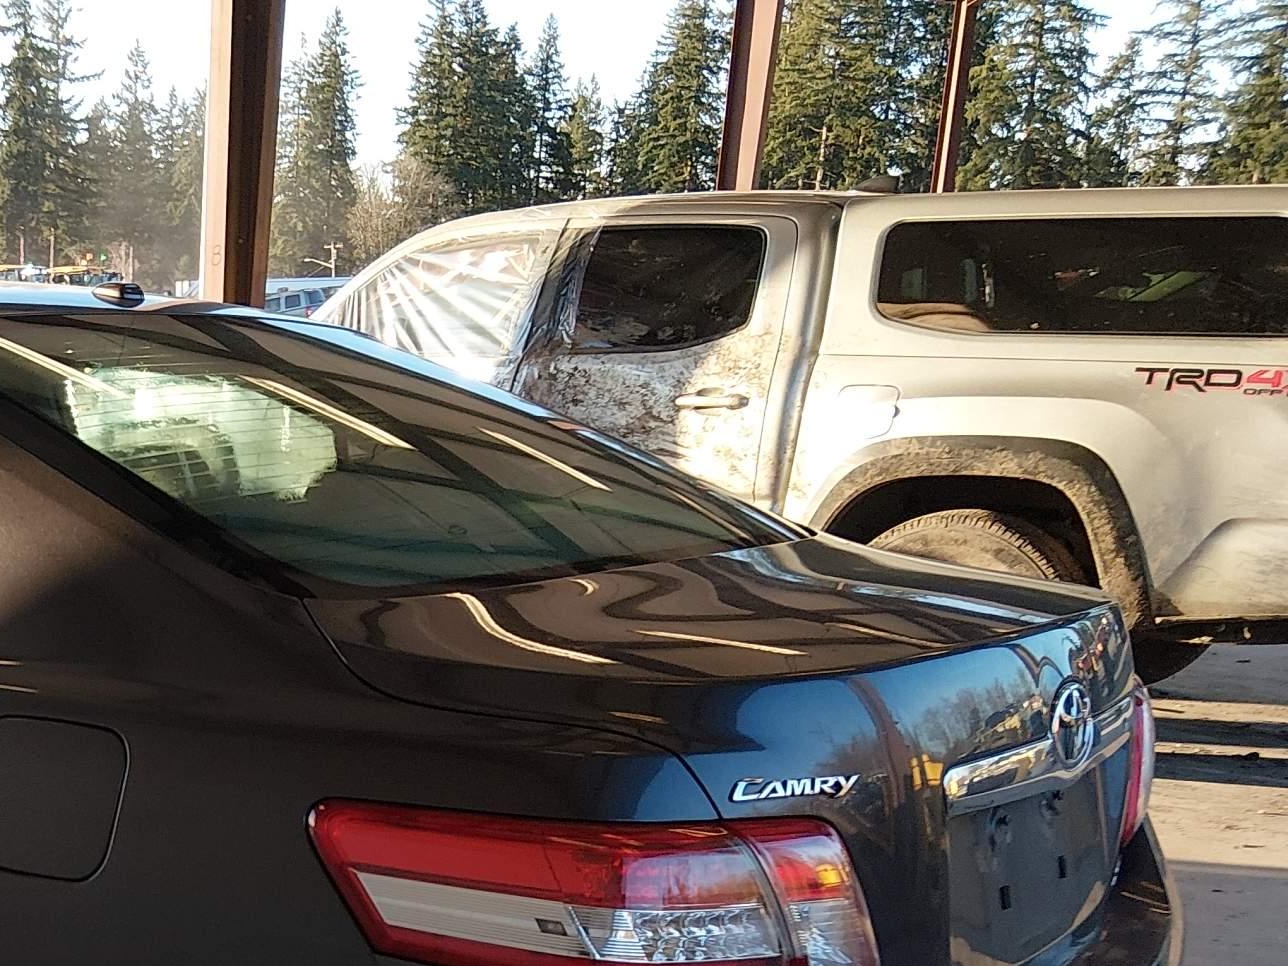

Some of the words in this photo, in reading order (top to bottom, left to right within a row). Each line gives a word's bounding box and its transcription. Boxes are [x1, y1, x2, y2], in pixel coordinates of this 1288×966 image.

[1135, 367, 1243, 393] TRD
[1246, 369, 1288, 390] 4
[730, 774, 860, 801] CAMRY
